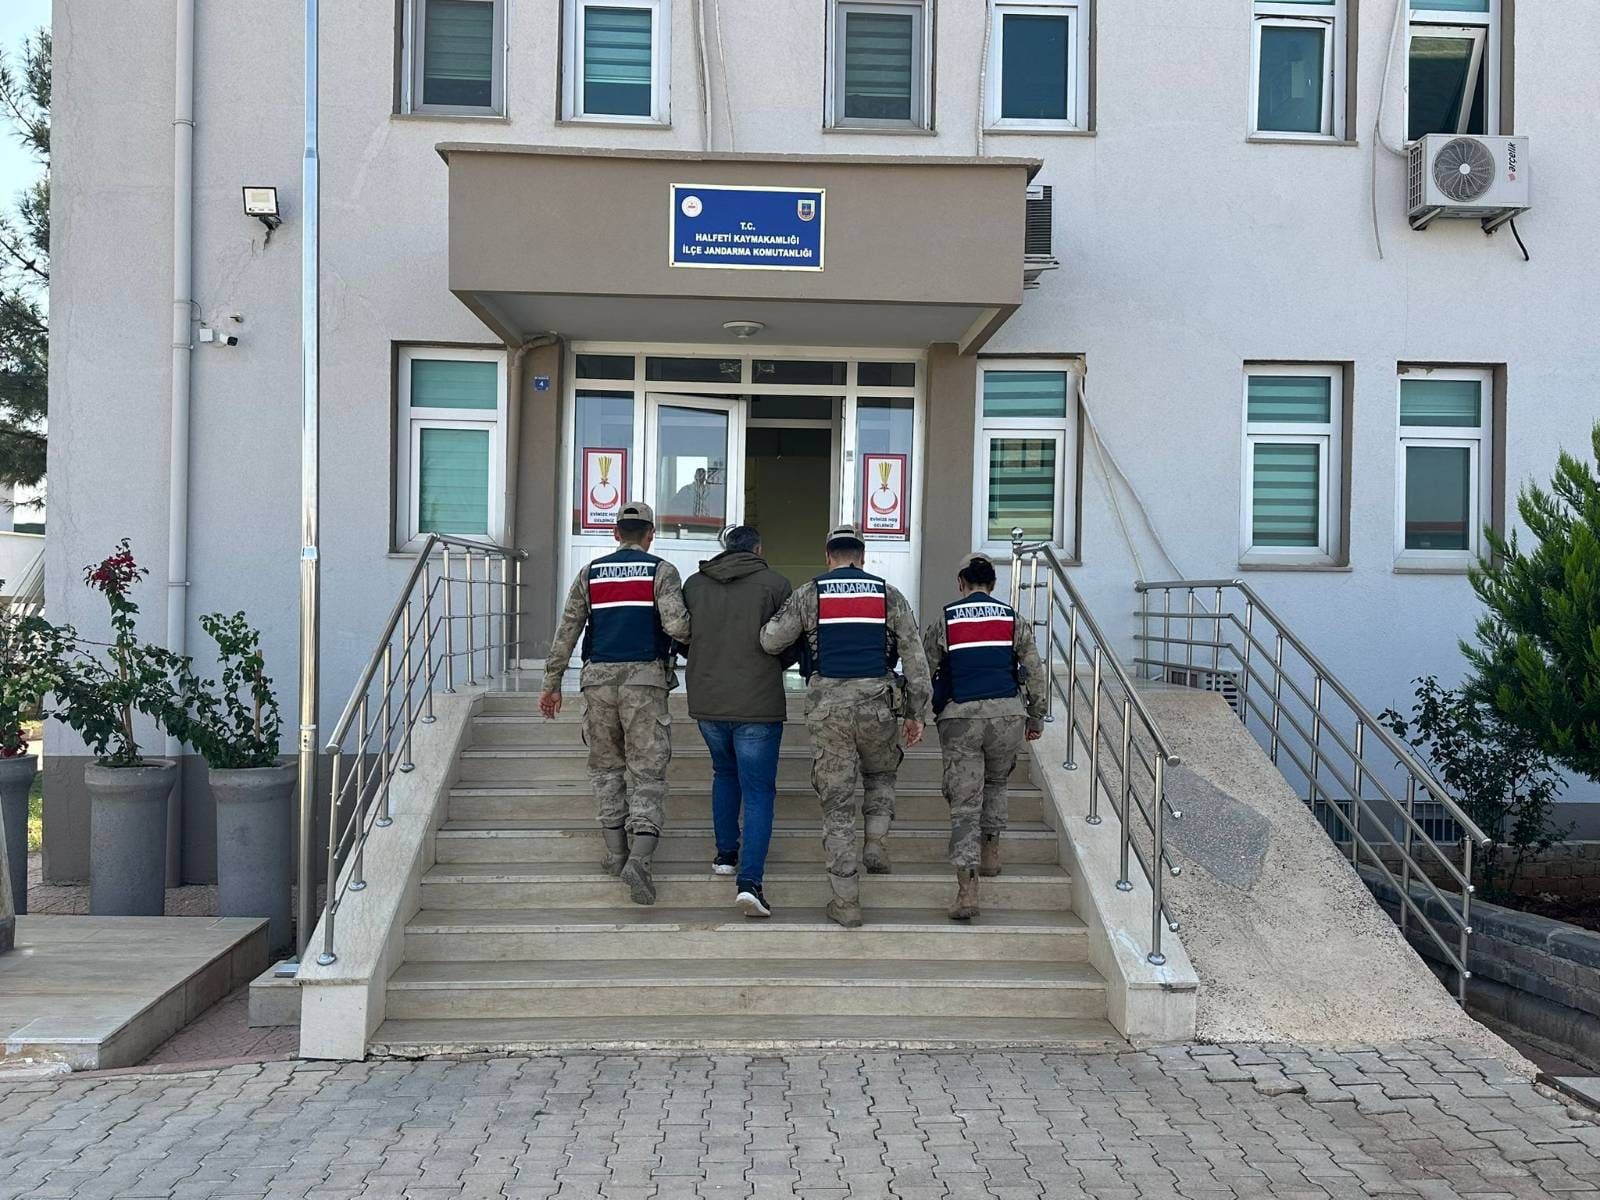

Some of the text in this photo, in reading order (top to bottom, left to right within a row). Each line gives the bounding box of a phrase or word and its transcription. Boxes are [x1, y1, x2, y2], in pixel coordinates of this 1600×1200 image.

[1507, 141, 1517, 173] arçelik
[740, 222, 756, 230] T.C.
[695, 233, 800, 244] HALFETİ KAYMAKAMLIĞI
[682, 244, 813, 258] İLÇE JANDARMA KOMUTANLIĞI
[596, 566, 649, 578] JANDARMA
[823, 582, 878, 594] JANDARMA
[953, 606, 1007, 618] JANDARMA
